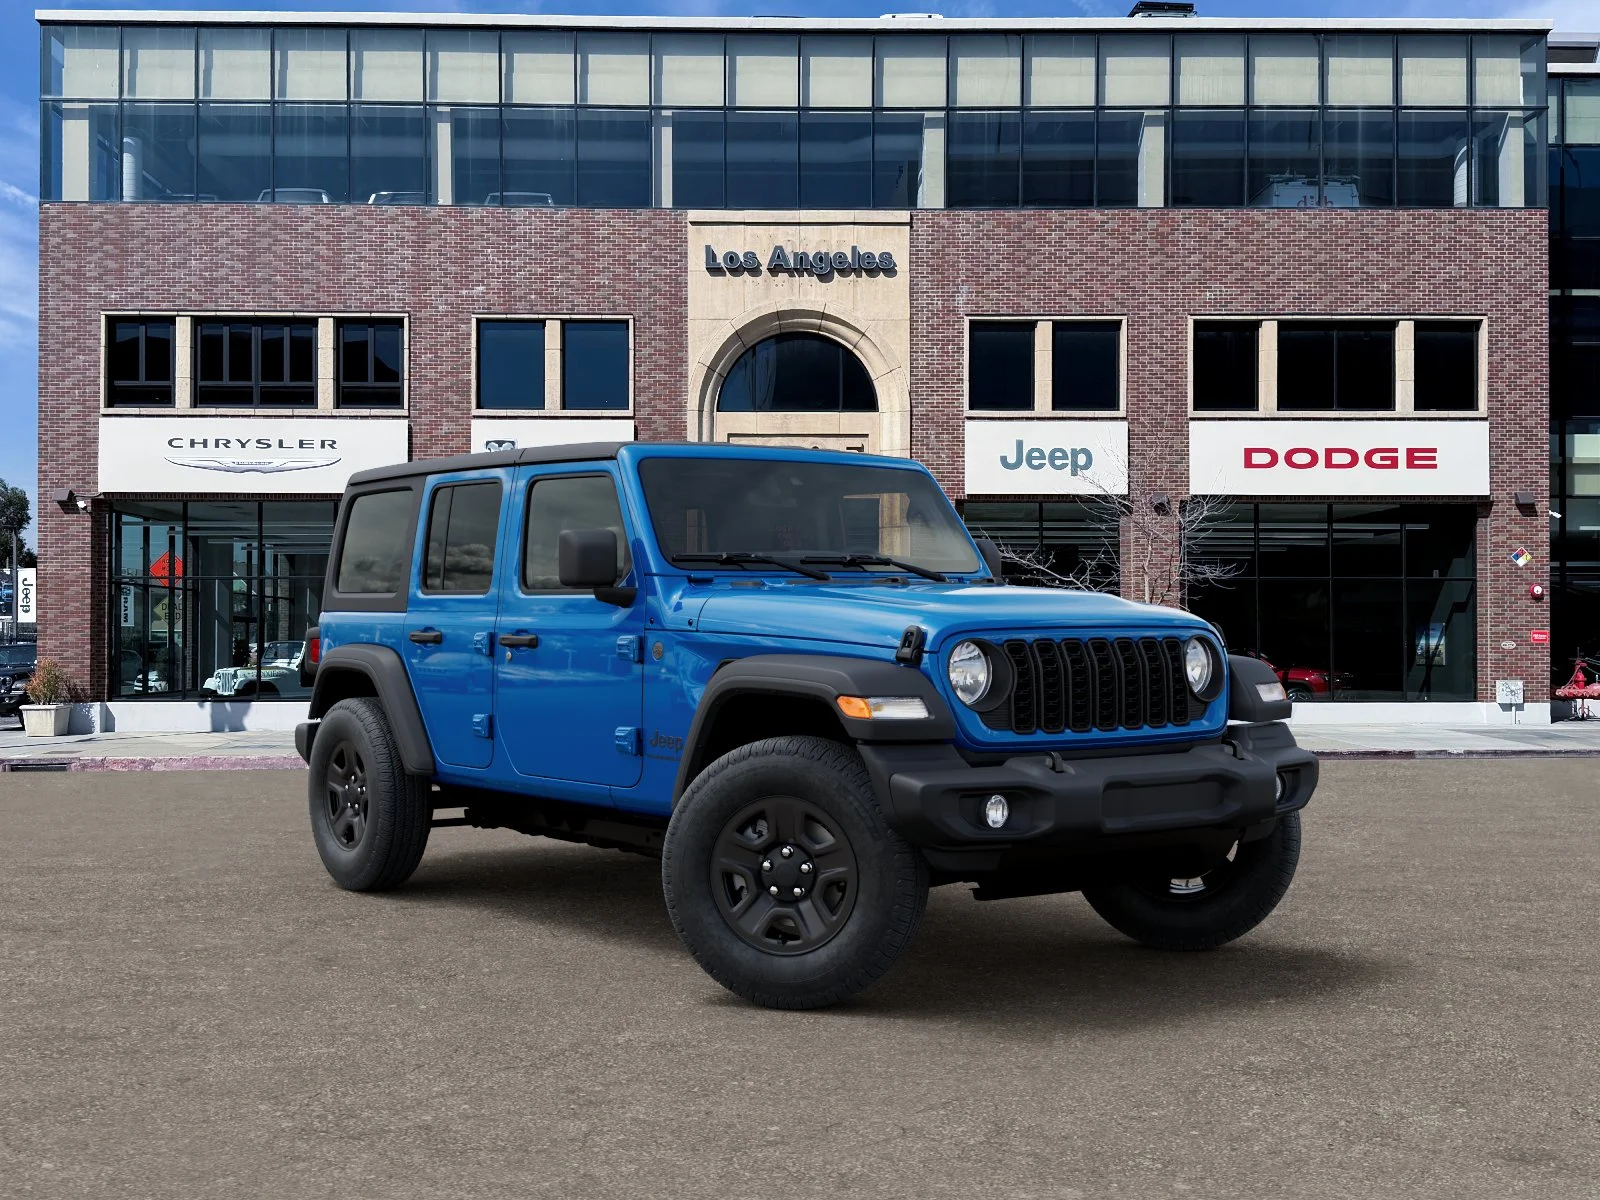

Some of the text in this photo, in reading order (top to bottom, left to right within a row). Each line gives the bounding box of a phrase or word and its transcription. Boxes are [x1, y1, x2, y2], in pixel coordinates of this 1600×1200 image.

[704, 244, 895, 275] Los Angeles
[167, 437, 338, 450] CHRYSLER
[1000, 439, 1093, 476] Jeep
[1243, 447, 1438, 469] DODGE
[20, 577, 34, 613] Jeep
[650, 729, 683, 753] Jeep
